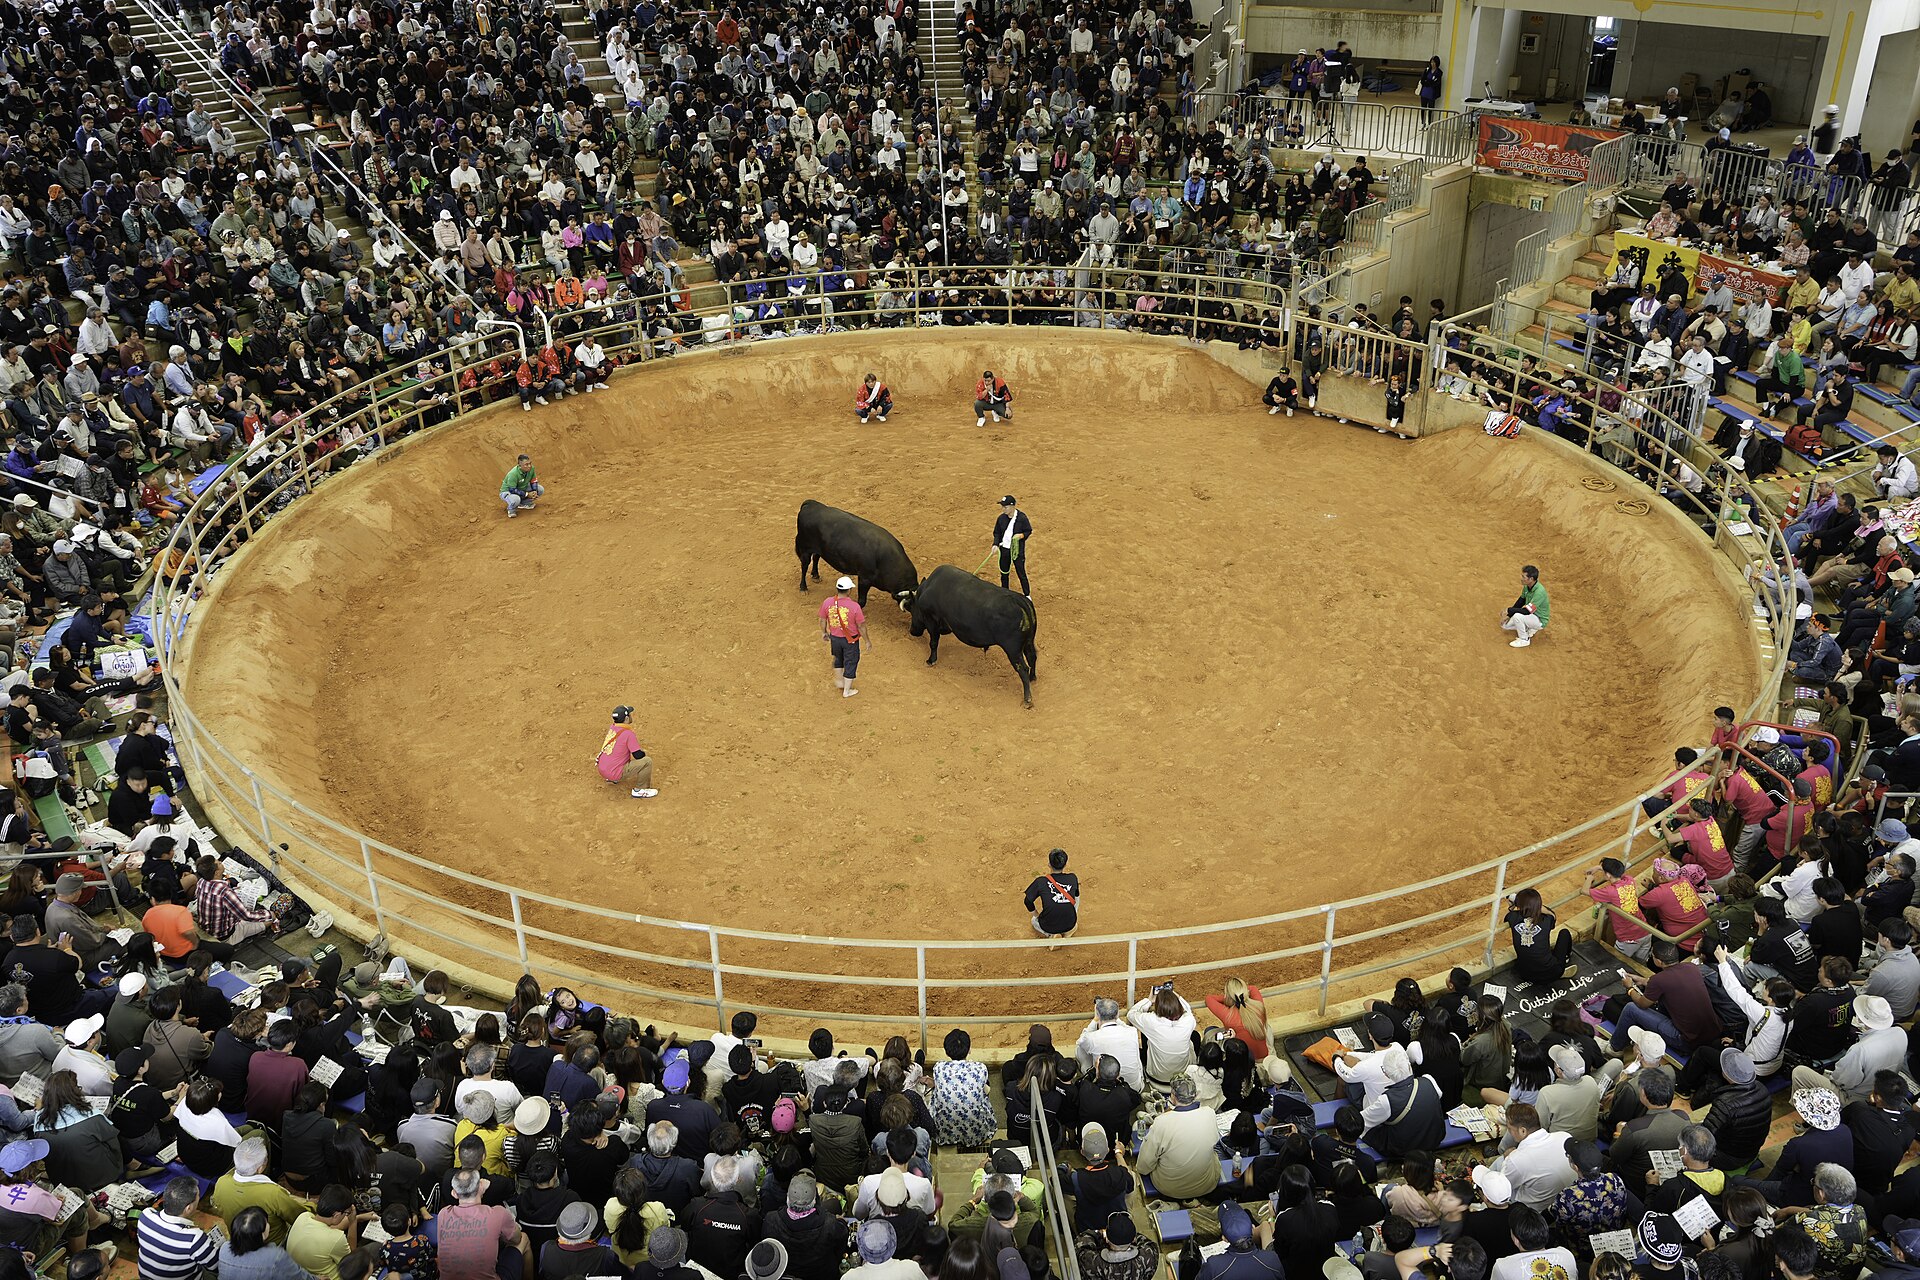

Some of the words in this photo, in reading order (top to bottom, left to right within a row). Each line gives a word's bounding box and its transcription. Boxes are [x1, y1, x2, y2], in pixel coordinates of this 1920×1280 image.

[1497, 144, 1549, 163] 闘牛のまち
[1552, 151, 1591, 169] うるま市
[1500, 160, 1535, 171] BULLFIGHT
[1536, 165, 1559, 174] TWON
[1559, 168, 1584, 178] URUMA
[1700, 265, 1742, 288] 闘牛まち
[1519, 988, 1567, 1012] Outside
[1569, 975, 1594, 991] Life
[711, 1220, 741, 1231] YOKOHAMA
